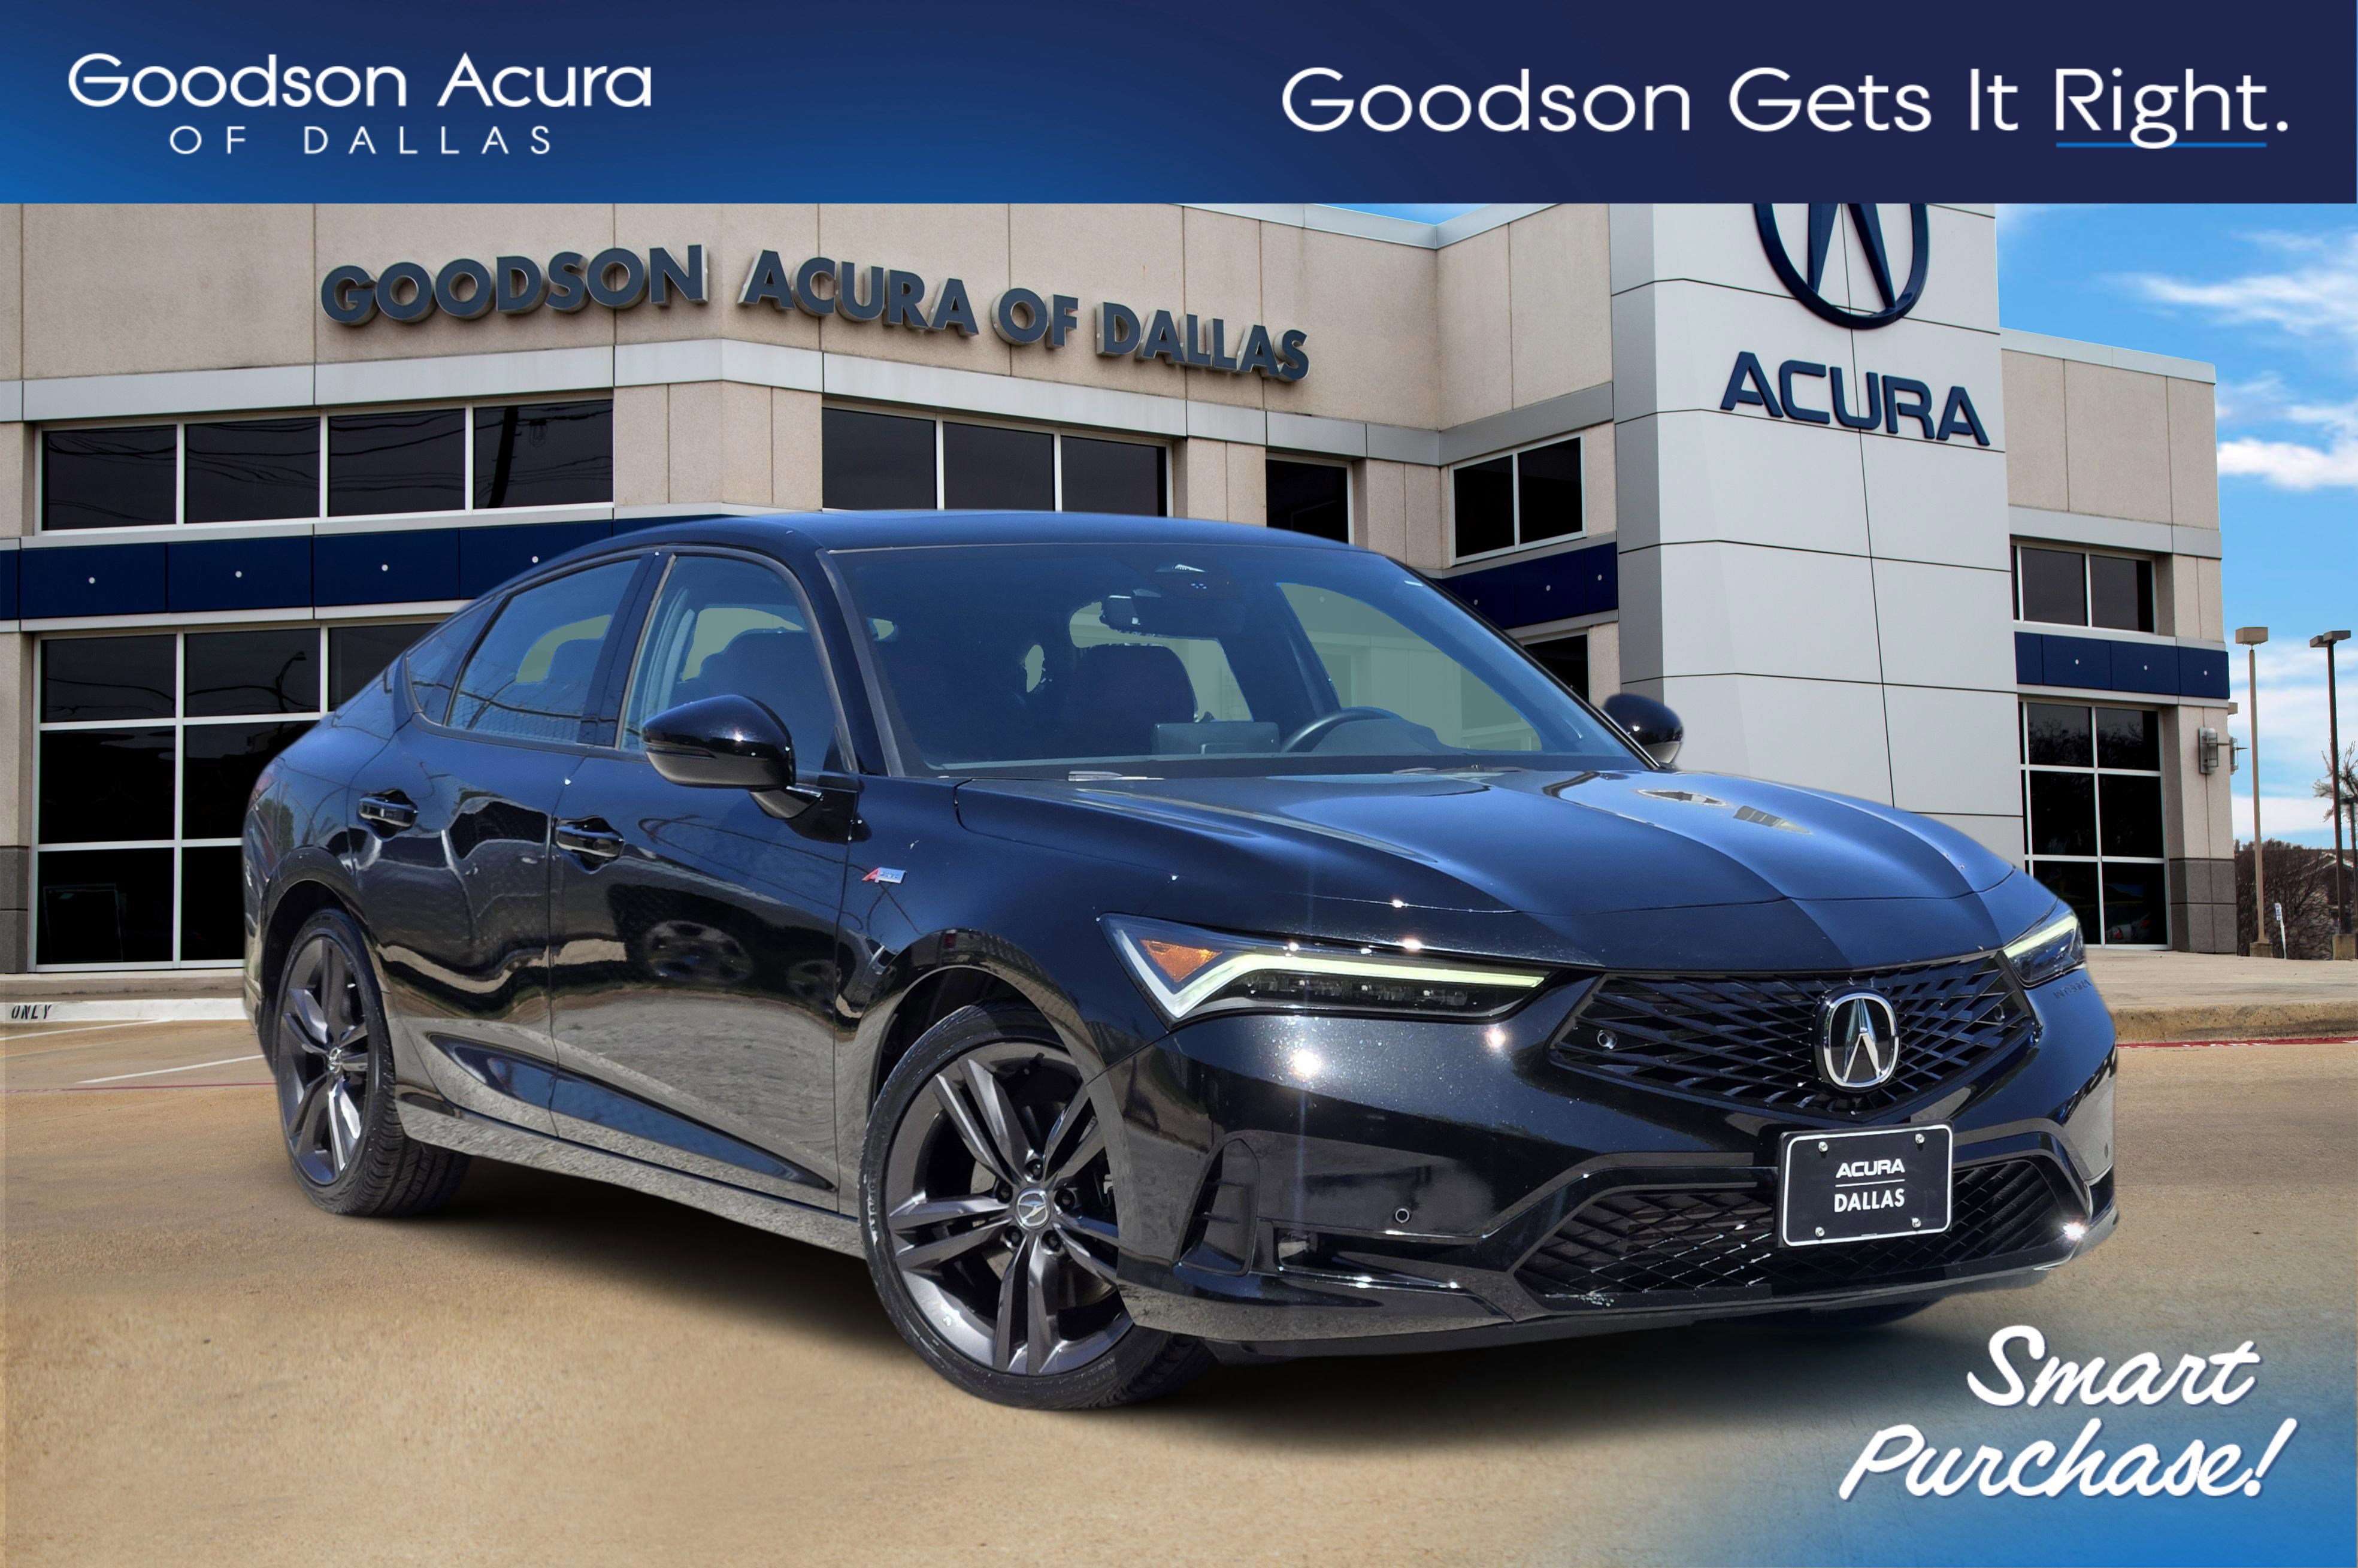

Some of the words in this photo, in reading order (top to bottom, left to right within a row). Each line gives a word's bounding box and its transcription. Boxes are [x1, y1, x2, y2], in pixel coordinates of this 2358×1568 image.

[321, 244, 708, 327] GOODSON
[737, 249, 979, 336] ACURA
[991, 287, 1079, 349] OF
[1096, 301, 1310, 382] DALLAS
[1720, 351, 1990, 447] ACURA
[11, 1004, 52, 1019] ONLY
[1835, 1158, 1905, 1178] ACURA
[1834, 1188, 1905, 1213] DALLAS
